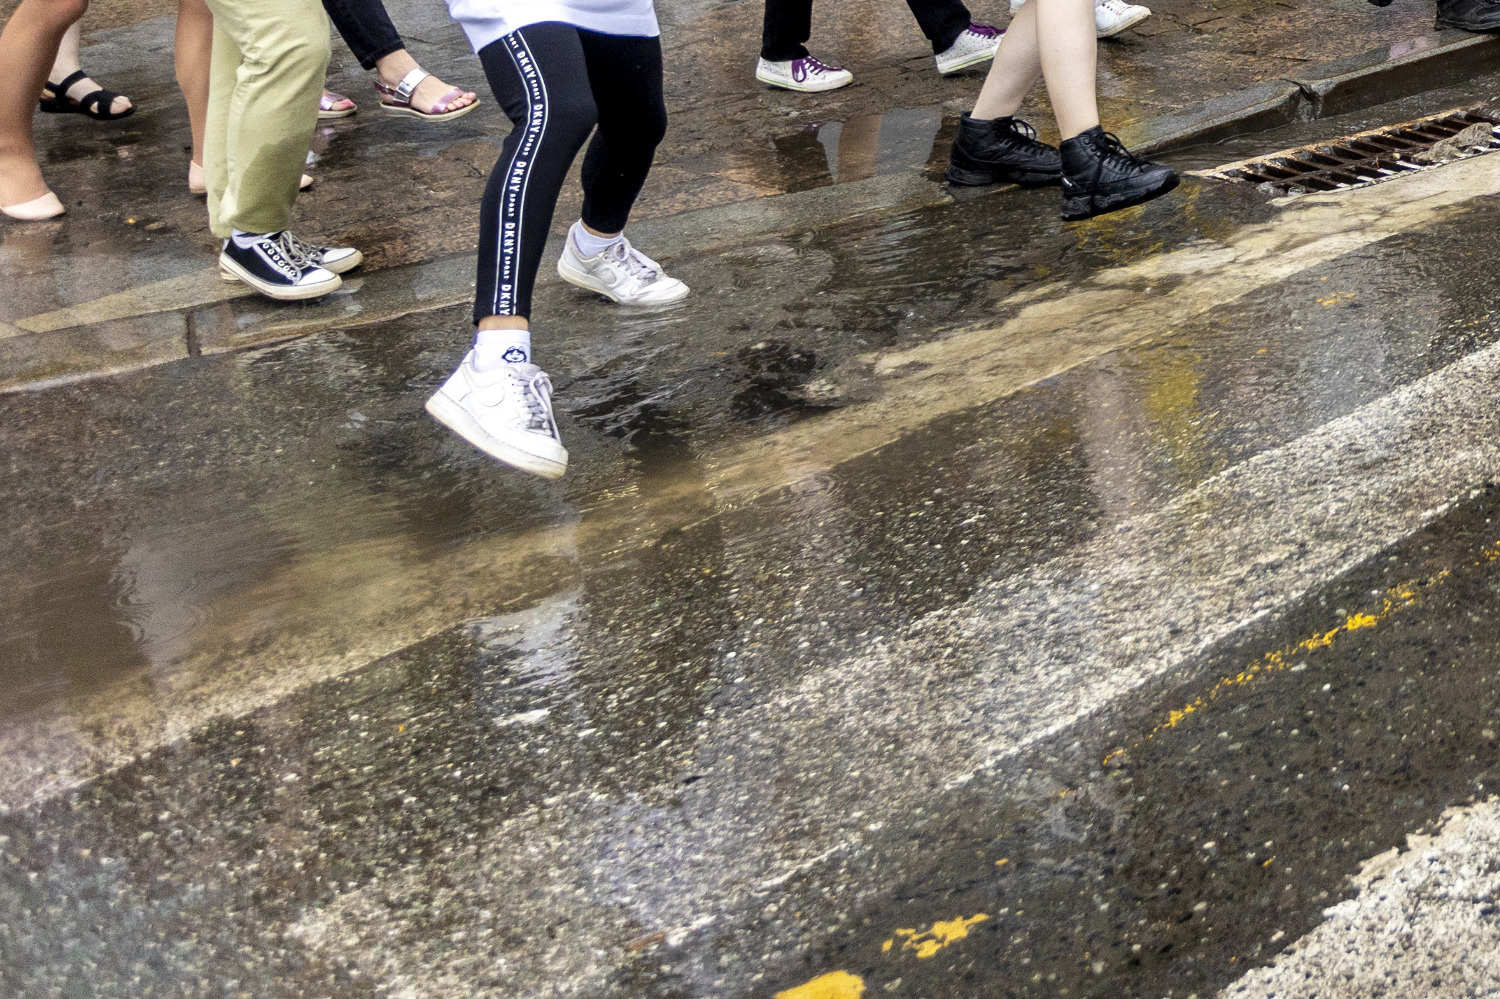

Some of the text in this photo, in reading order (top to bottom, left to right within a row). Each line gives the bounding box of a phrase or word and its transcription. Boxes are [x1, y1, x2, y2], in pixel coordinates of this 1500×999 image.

[516, 50, 537, 78] DKNY
[531, 79, 541, 100] SPORT
[529, 103, 544, 133] DKNY
[522, 134, 535, 156] SPORT
[508, 161, 527, 192] DKNY
[508, 193, 517, 217] SPORT
[503, 222, 516, 255] DKNY
[503, 256, 511, 279] SPORT
[499, 284, 512, 316] DKNY
